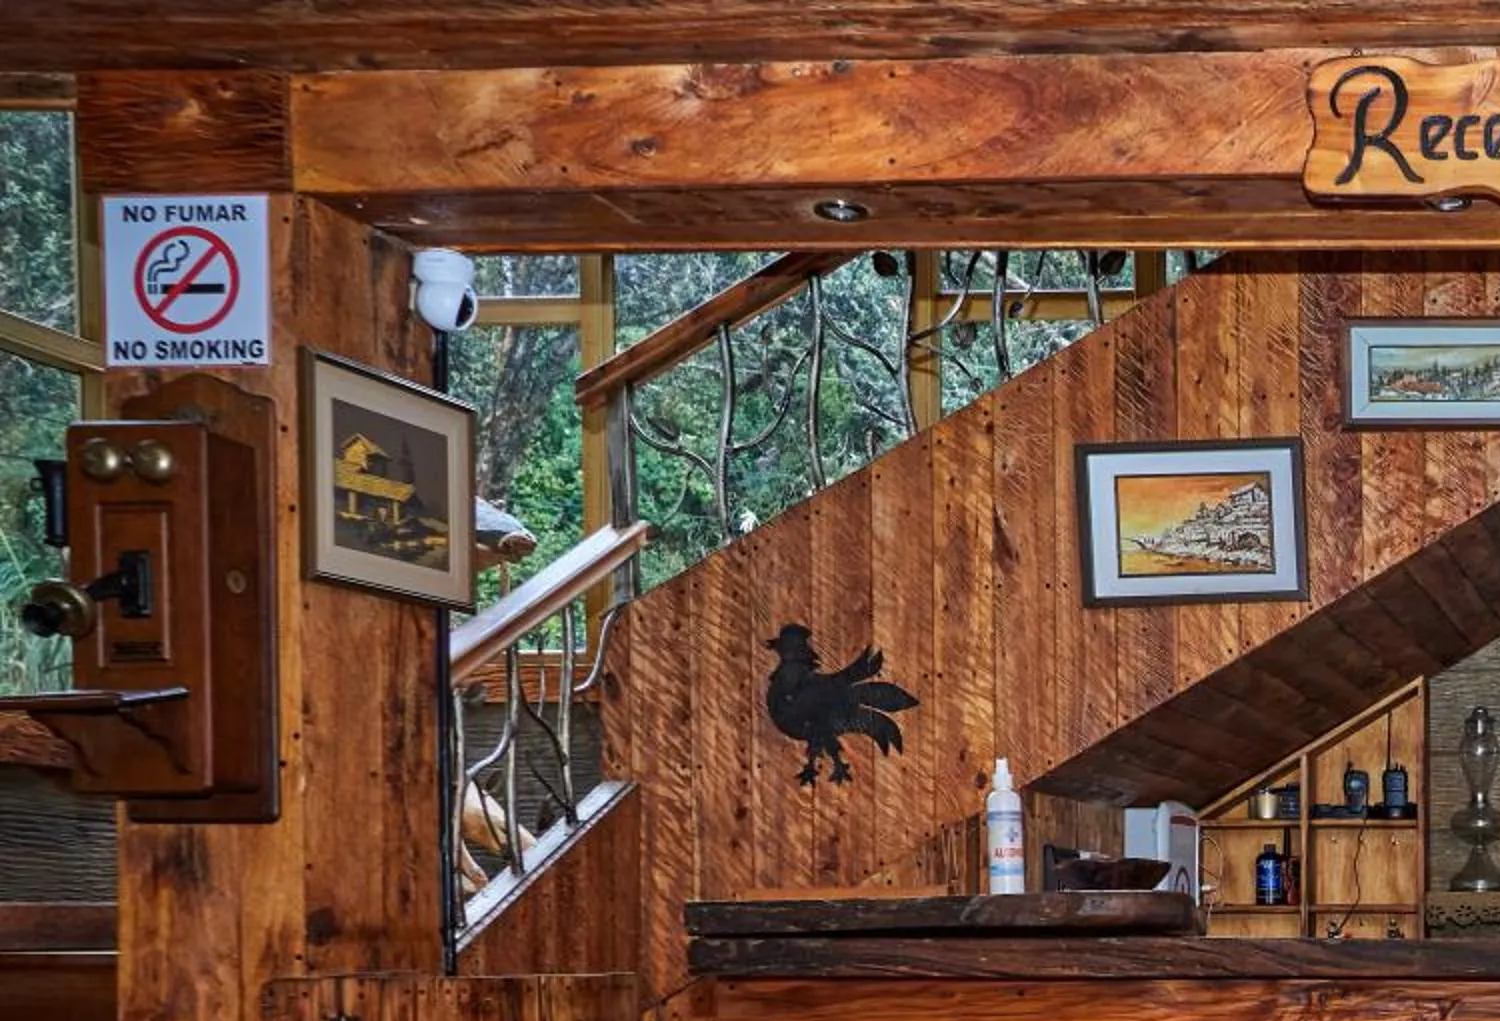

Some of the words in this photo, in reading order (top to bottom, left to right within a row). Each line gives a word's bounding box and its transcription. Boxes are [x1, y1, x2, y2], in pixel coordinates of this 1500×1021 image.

[122, 205, 157, 223] NO
[165, 204, 247, 222] FUMAR
[113, 341, 148, 360] NO
[155, 339, 265, 360] SMOKING
